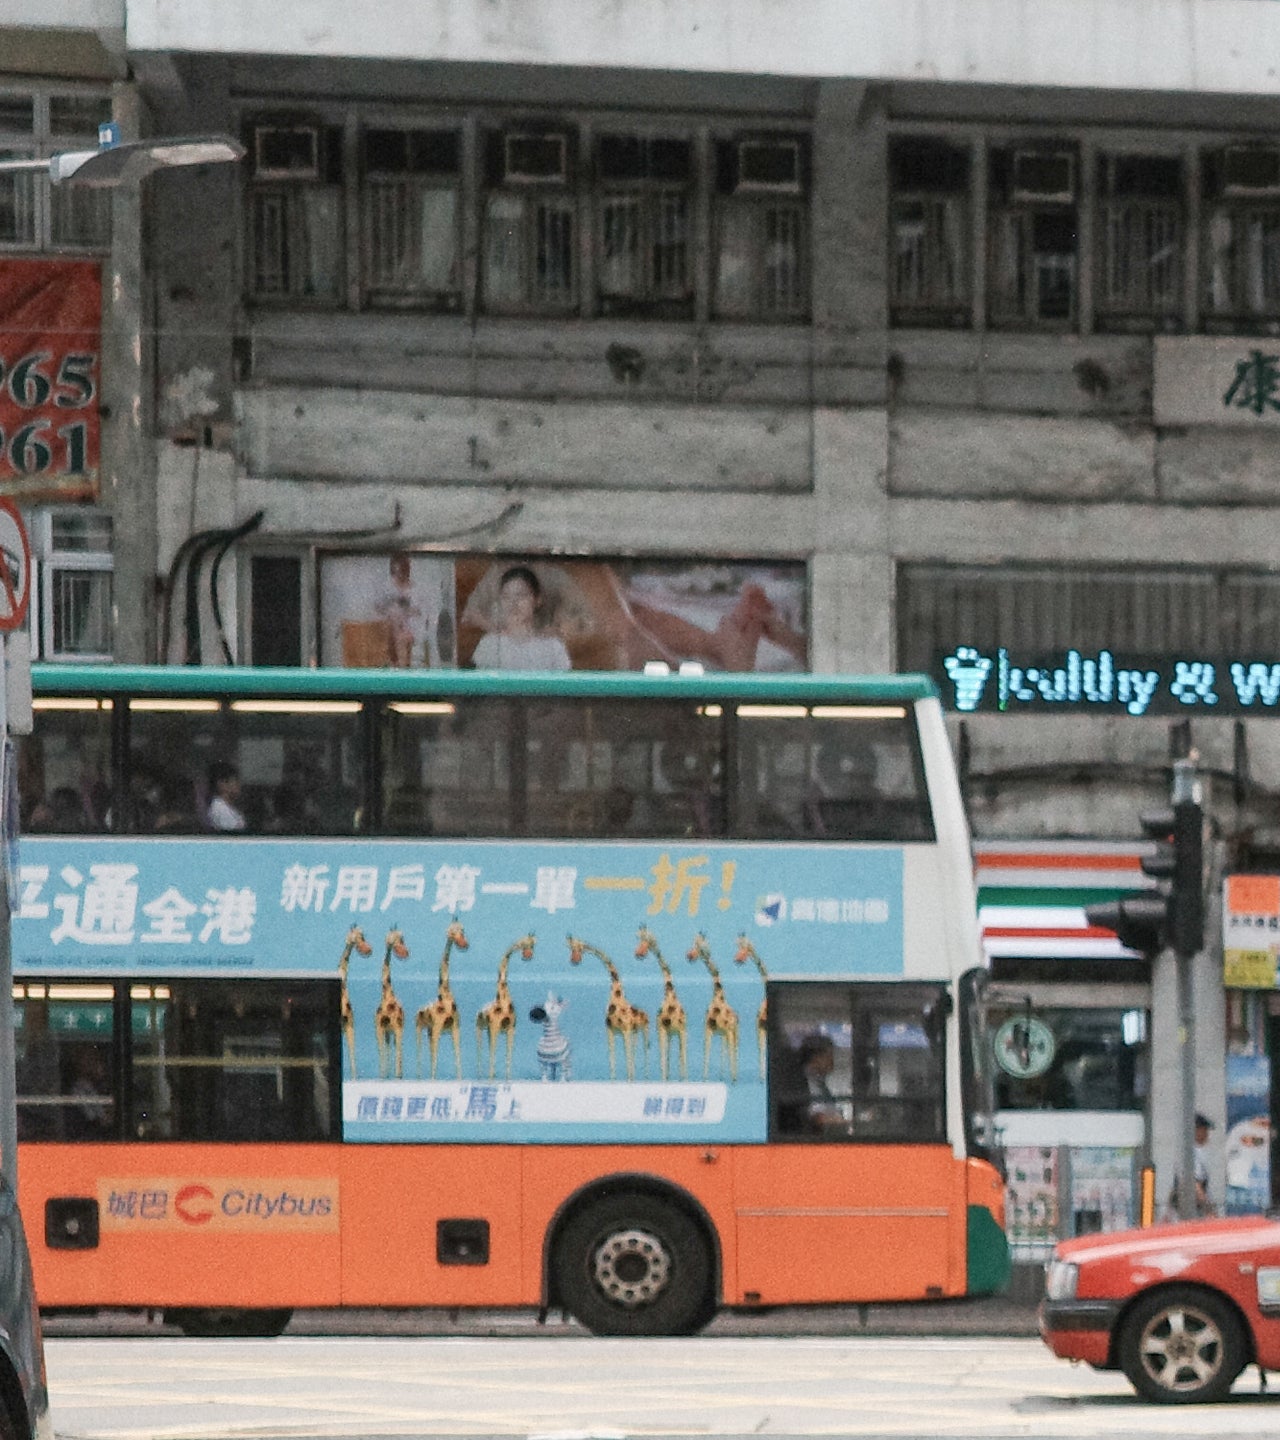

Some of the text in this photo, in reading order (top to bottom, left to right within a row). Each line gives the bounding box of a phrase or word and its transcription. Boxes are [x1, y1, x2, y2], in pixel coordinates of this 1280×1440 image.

[0, 351, 97, 409] 65
[0, 418, 90, 475] 61
[221, 1190, 332, 1219] Citybus
